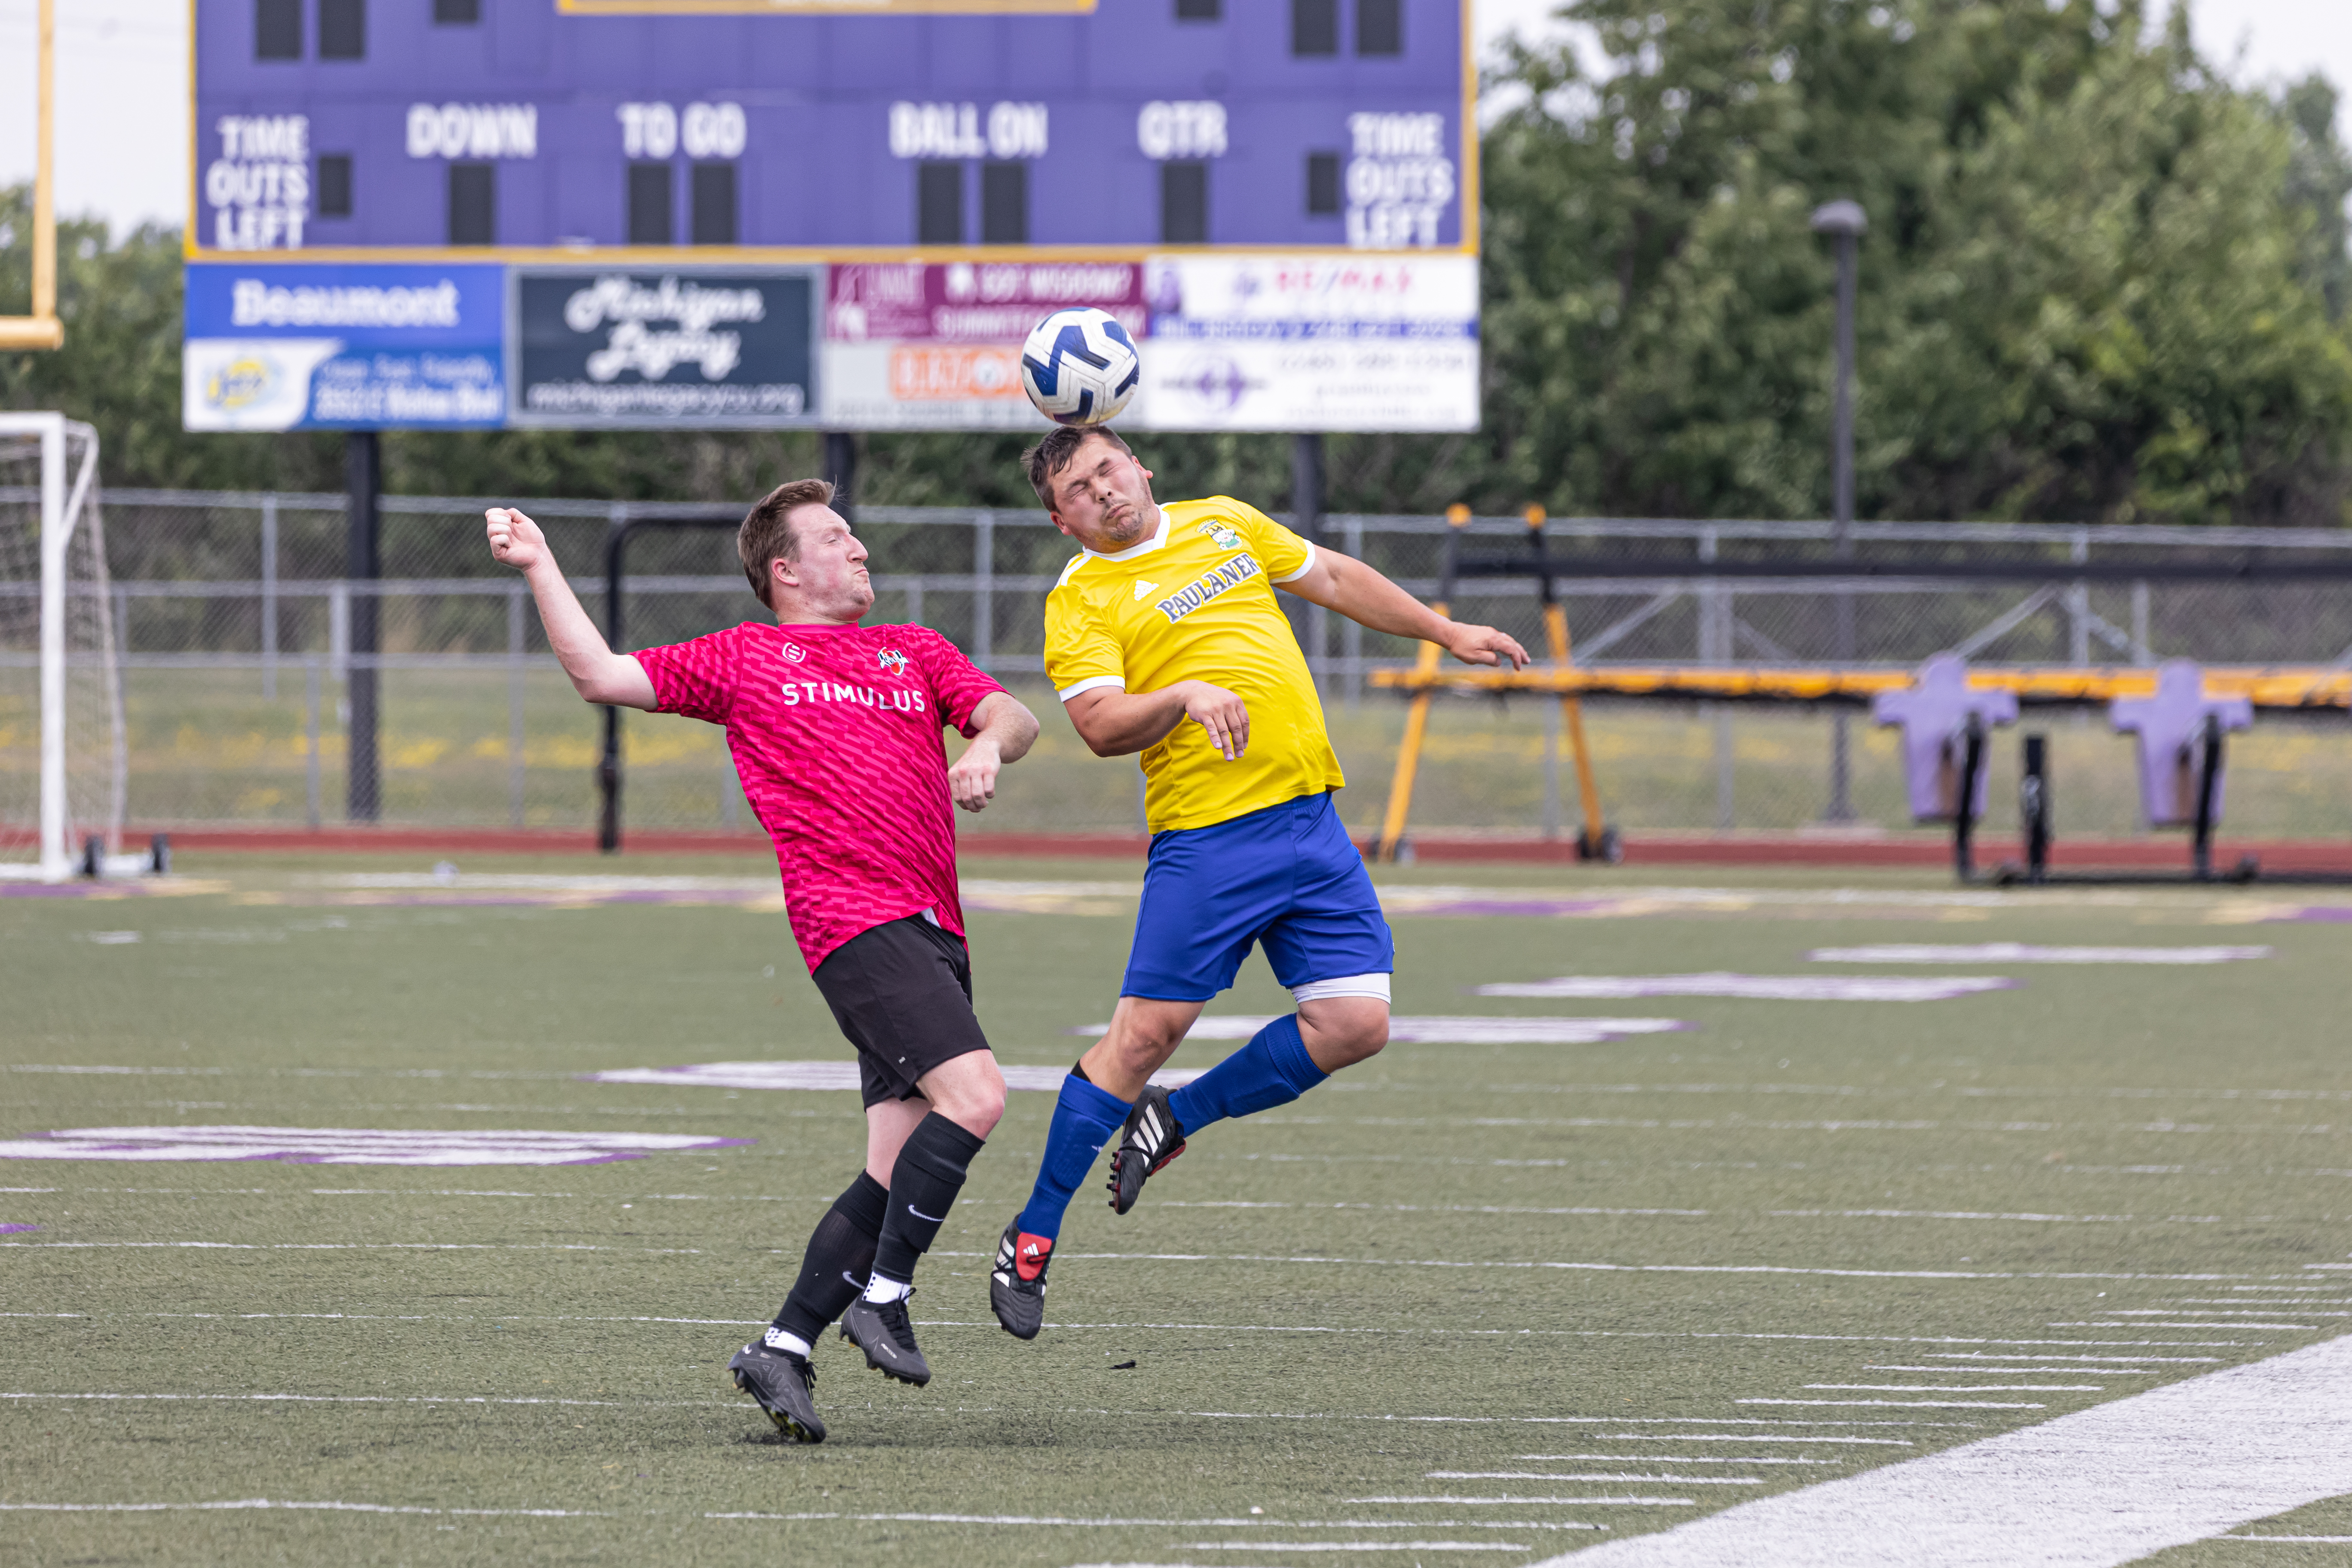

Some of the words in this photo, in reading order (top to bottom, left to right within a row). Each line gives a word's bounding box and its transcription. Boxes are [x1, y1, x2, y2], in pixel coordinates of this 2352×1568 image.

[217, 115, 309, 159] TIME
[406, 103, 537, 158] DOWN
[616, 101, 678, 159] TO
[683, 101, 746, 159] GO
[889, 101, 986, 158] BALL
[987, 101, 1048, 159] ON
[1138, 101, 1228, 159] QTR
[1348, 112, 1444, 156] TIME
[207, 160, 308, 207] OUTS
[1346, 156, 1455, 206] OUTS
[216, 206, 306, 251] LEFT
[1345, 205, 1441, 250] LEFT
[232, 278, 460, 327] Beaumont
[1134, 583, 1160, 601] adidas
[1155, 552, 1261, 624] PAULANER
[782, 682, 925, 713] STIMULUS
